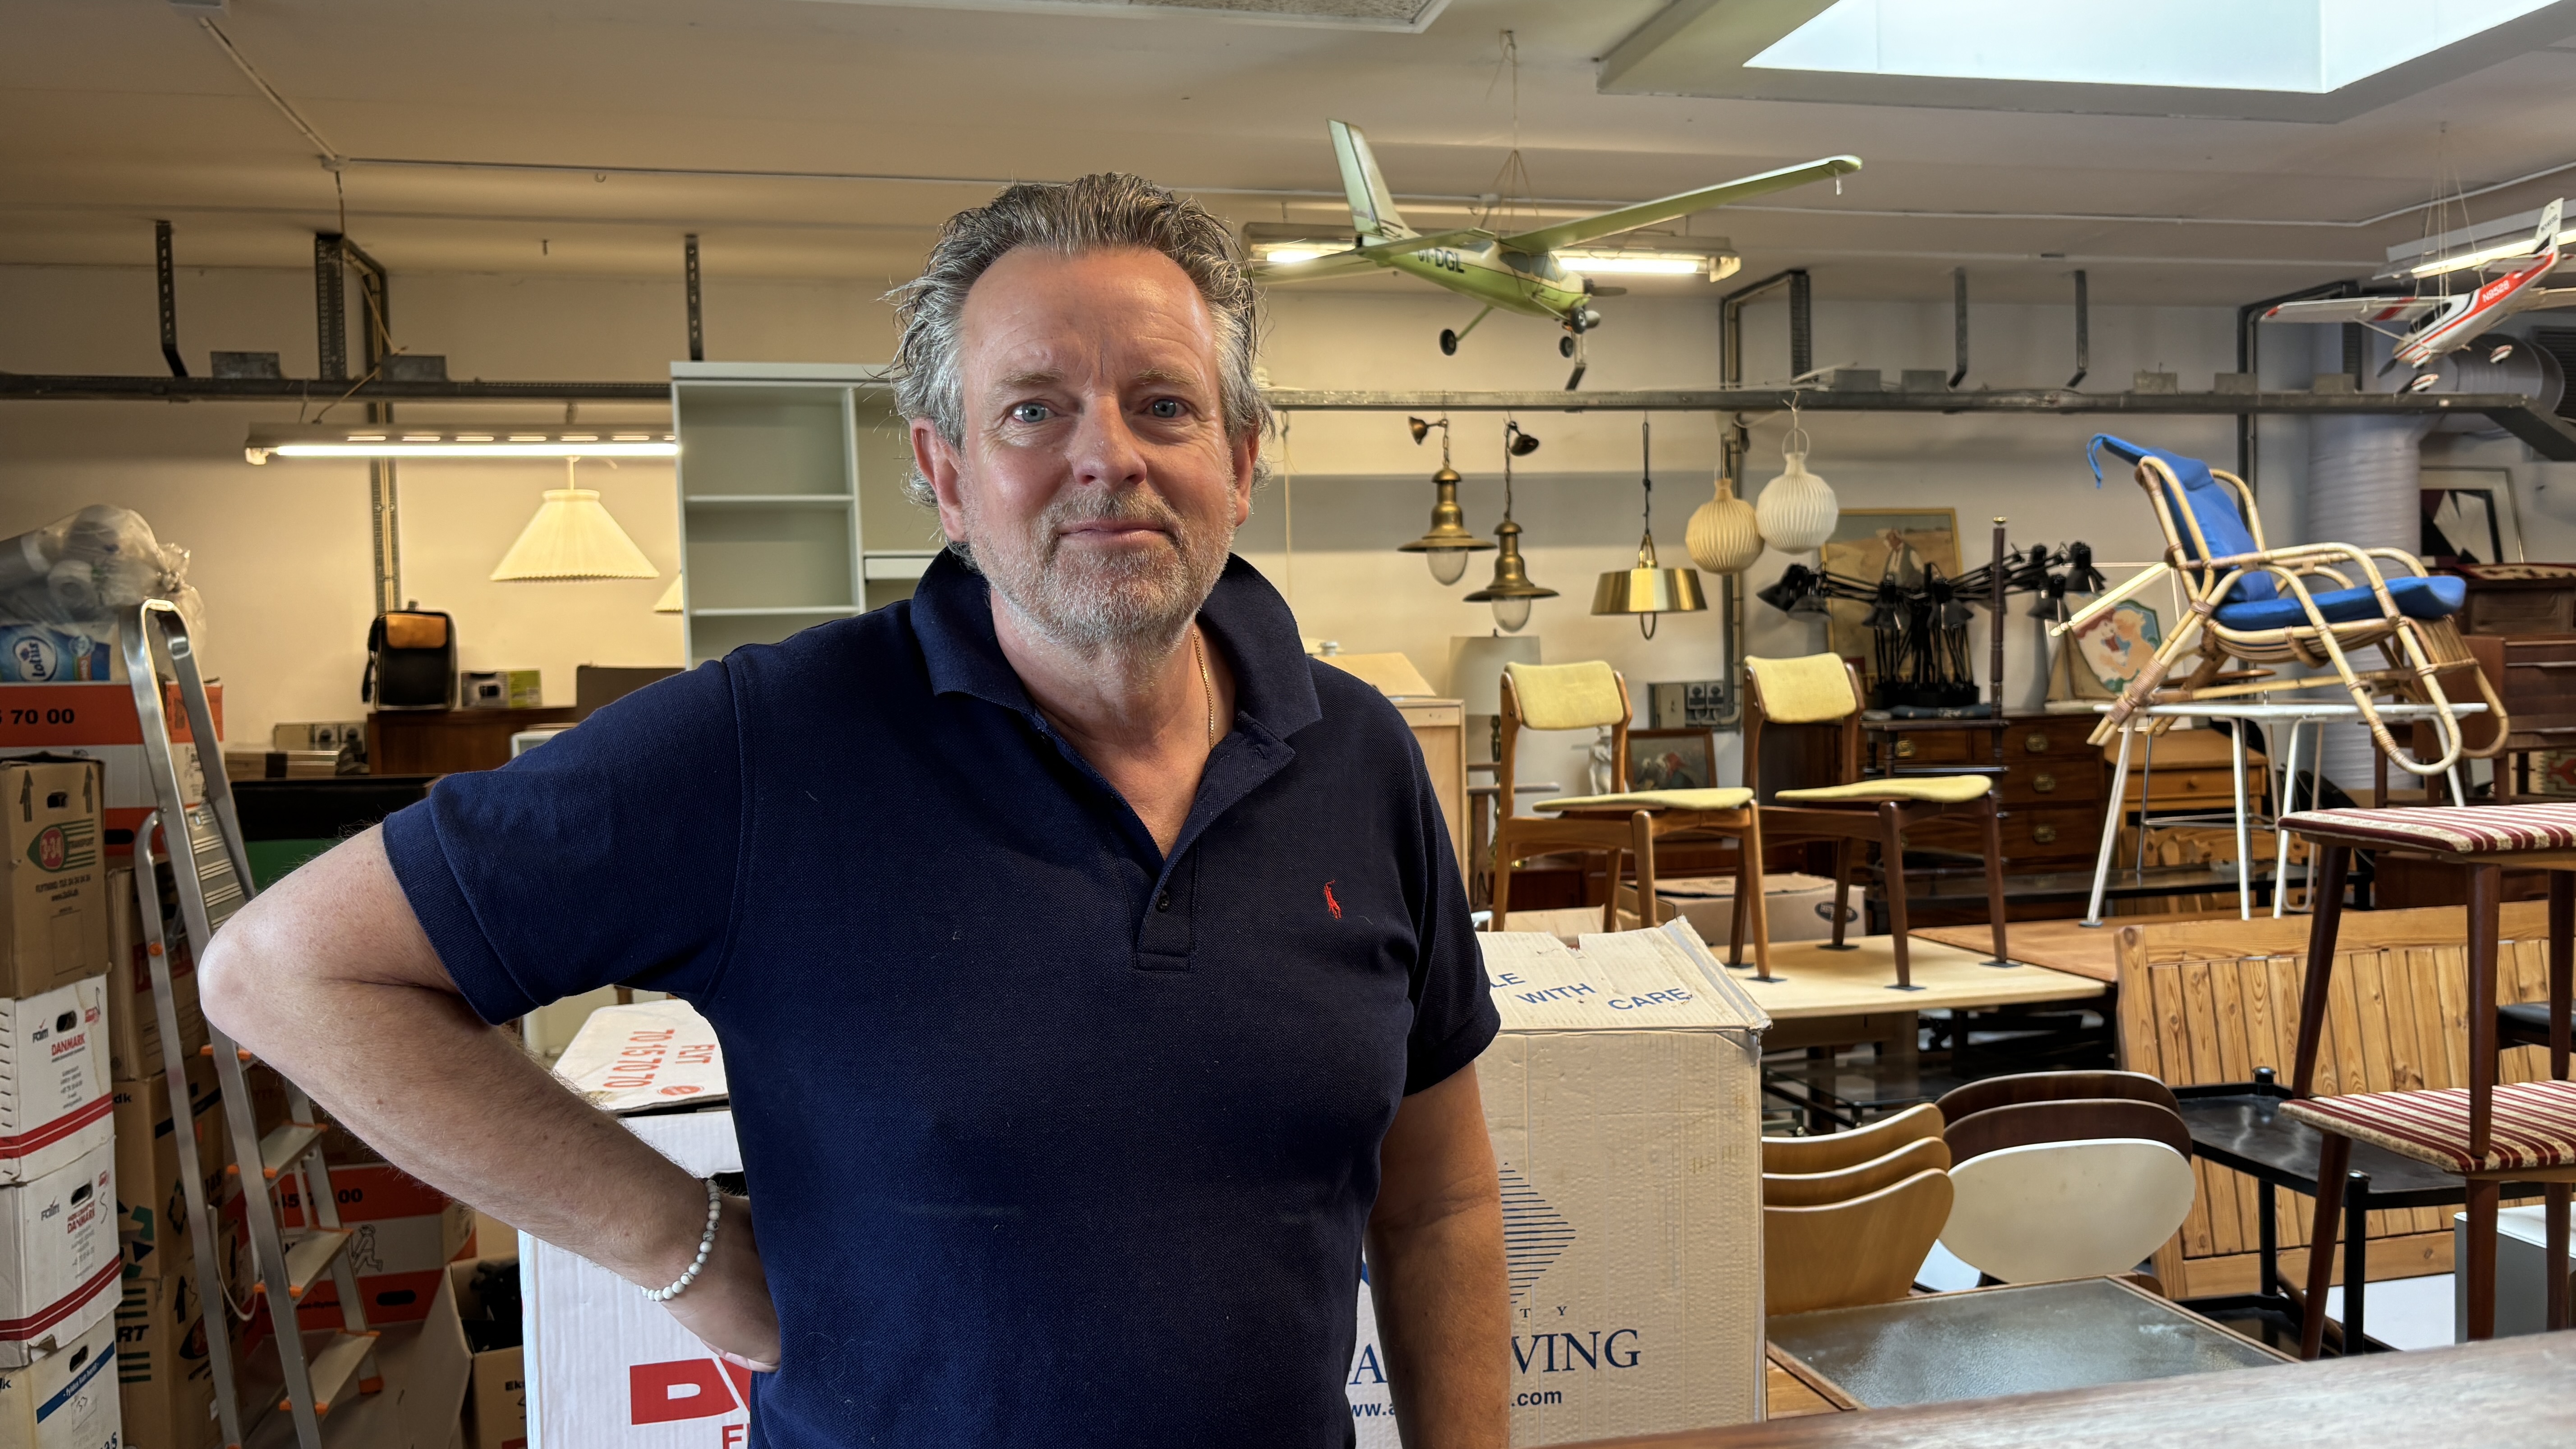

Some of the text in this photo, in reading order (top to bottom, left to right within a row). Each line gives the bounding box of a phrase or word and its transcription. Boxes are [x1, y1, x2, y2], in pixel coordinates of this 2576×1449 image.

[10, 709, 38, 725] 70
[47, 708, 74, 724] 00
[1515, 983, 1596, 1004] WITH
[1607, 988, 1693, 1010] CARE
[52, 1033, 86, 1056] DANMARK
[338, 1188, 363, 1203] 00
